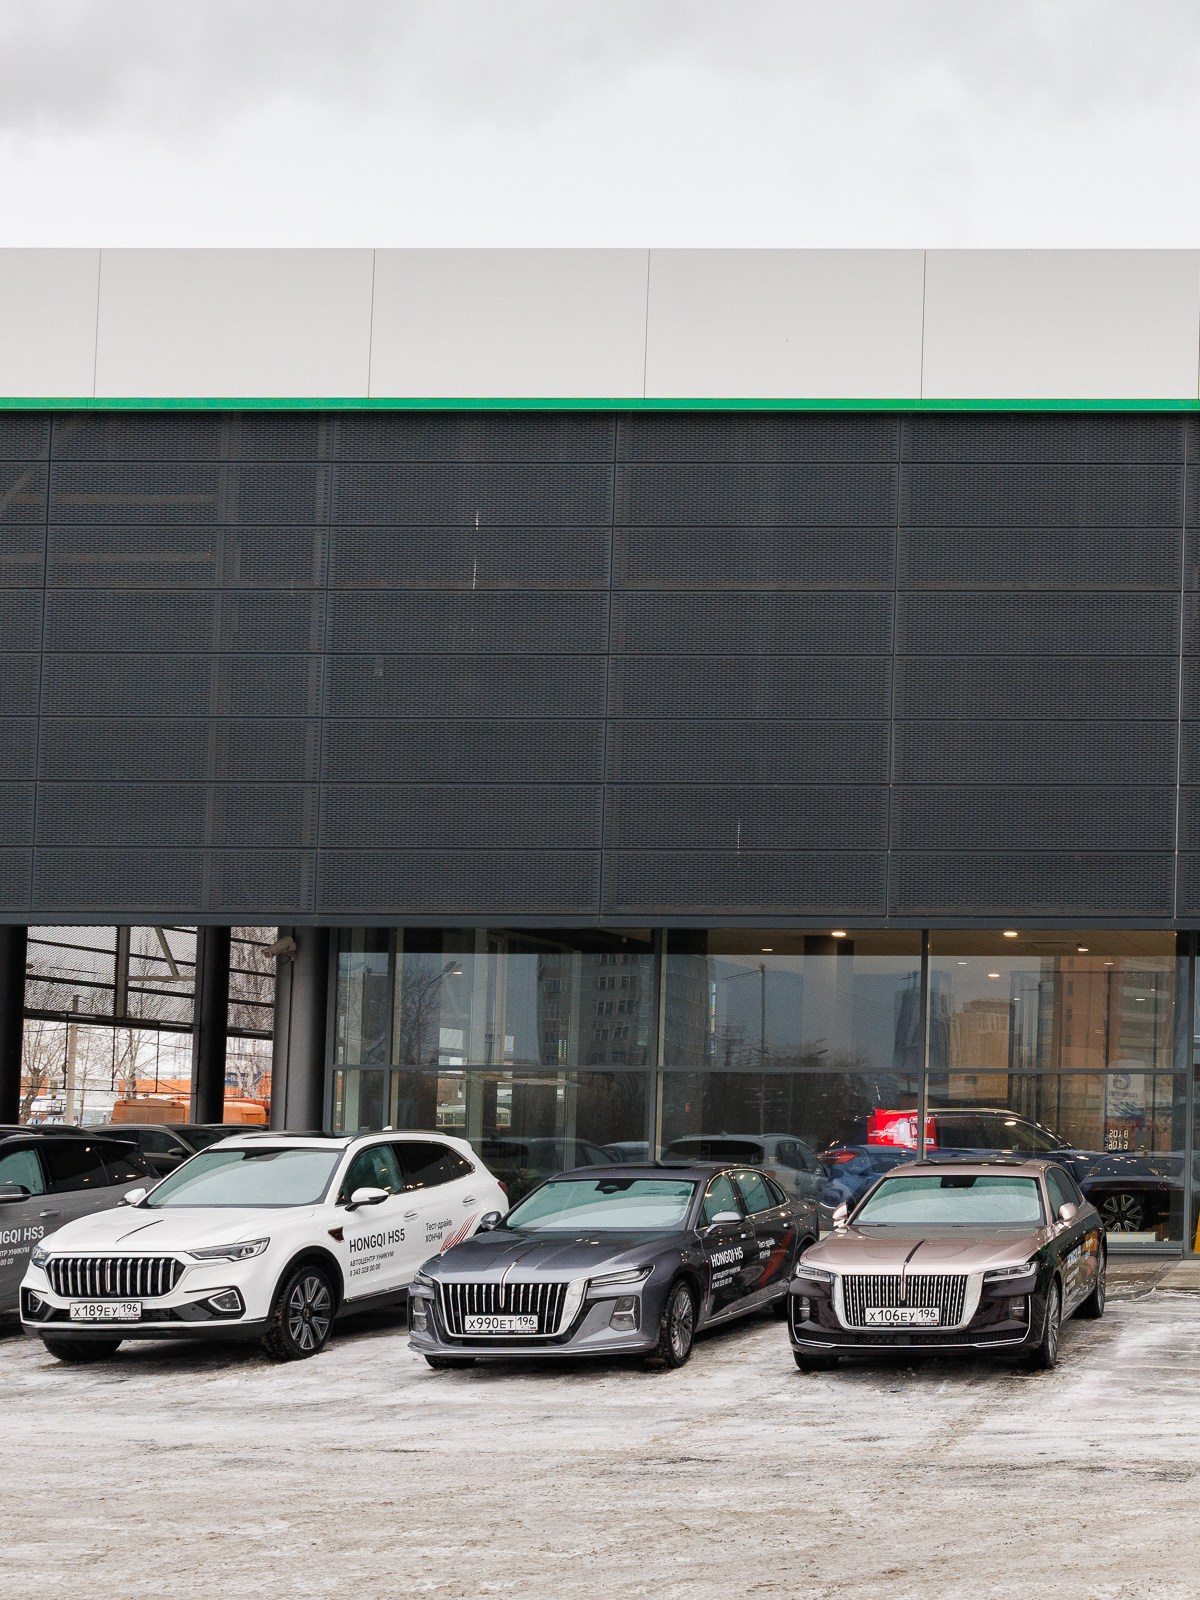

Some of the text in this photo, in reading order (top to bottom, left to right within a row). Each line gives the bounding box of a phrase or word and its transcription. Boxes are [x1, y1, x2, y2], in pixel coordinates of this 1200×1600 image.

[426, 1219, 452, 1231] Тест-драйв
[24, 1226, 44, 1240] HS3
[425, 1231, 443, 1243] ХОНЧИ
[349, 1228, 406, 1253] HONGQI HS5
[350, 1251, 394, 1267] АВТОЦЕНТР УНИКУМ
[710, 1246, 744, 1267] HONGQI H5
[73, 1304, 138, 1316] Х189ЕУ 196
[869, 1309, 936, 1321] Х106ЕУ 196
[468, 1316, 535, 1329] Х990ЕТ 196
